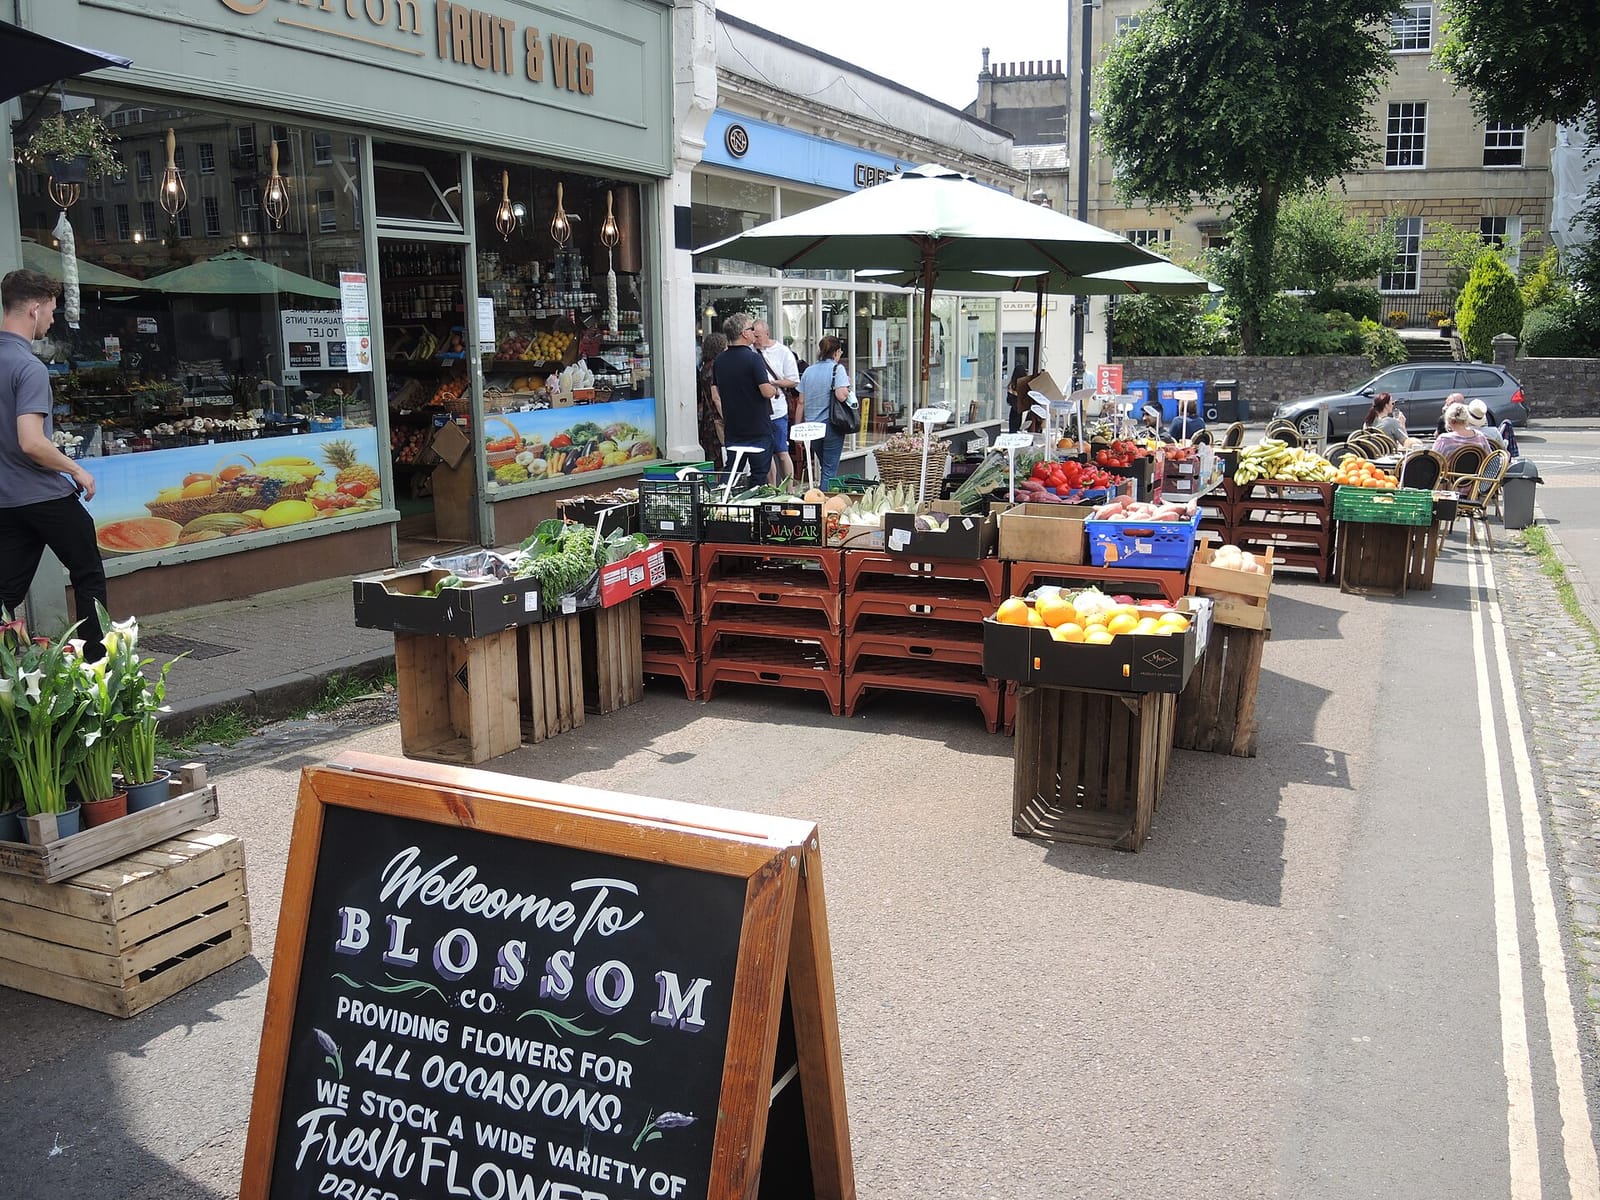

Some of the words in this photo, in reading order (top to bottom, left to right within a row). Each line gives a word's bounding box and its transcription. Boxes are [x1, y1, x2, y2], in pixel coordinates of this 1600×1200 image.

[435, 0, 516, 75] FRUIT
[525, 27, 545, 82] &
[550, 32, 595, 96] VEG
[380, 846, 576, 933] Welcome
[570, 877, 644, 945] To
[335, 906, 712, 1032] BLOSSOM
[459, 988, 497, 1014] CO
[336, 996, 449, 1043] PROVIDING
[461, 1025, 574, 1073] FLOWERS
[580, 1052, 633, 1089] FOR
[355, 1040, 411, 1081] ALL
[421, 1054, 623, 1134] OCCASIONS.
[295, 1107, 416, 1179] Fresh
[421, 1136, 609, 1200] FLOW
[316, 1078, 350, 1109] WE
[360, 1090, 439, 1133] STOCK
[448, 1115, 464, 1140] A
[475, 1121, 537, 1160] WIDE
[548, 1142, 647, 1189] VARIETY
[649, 1172, 687, 1199] OF
